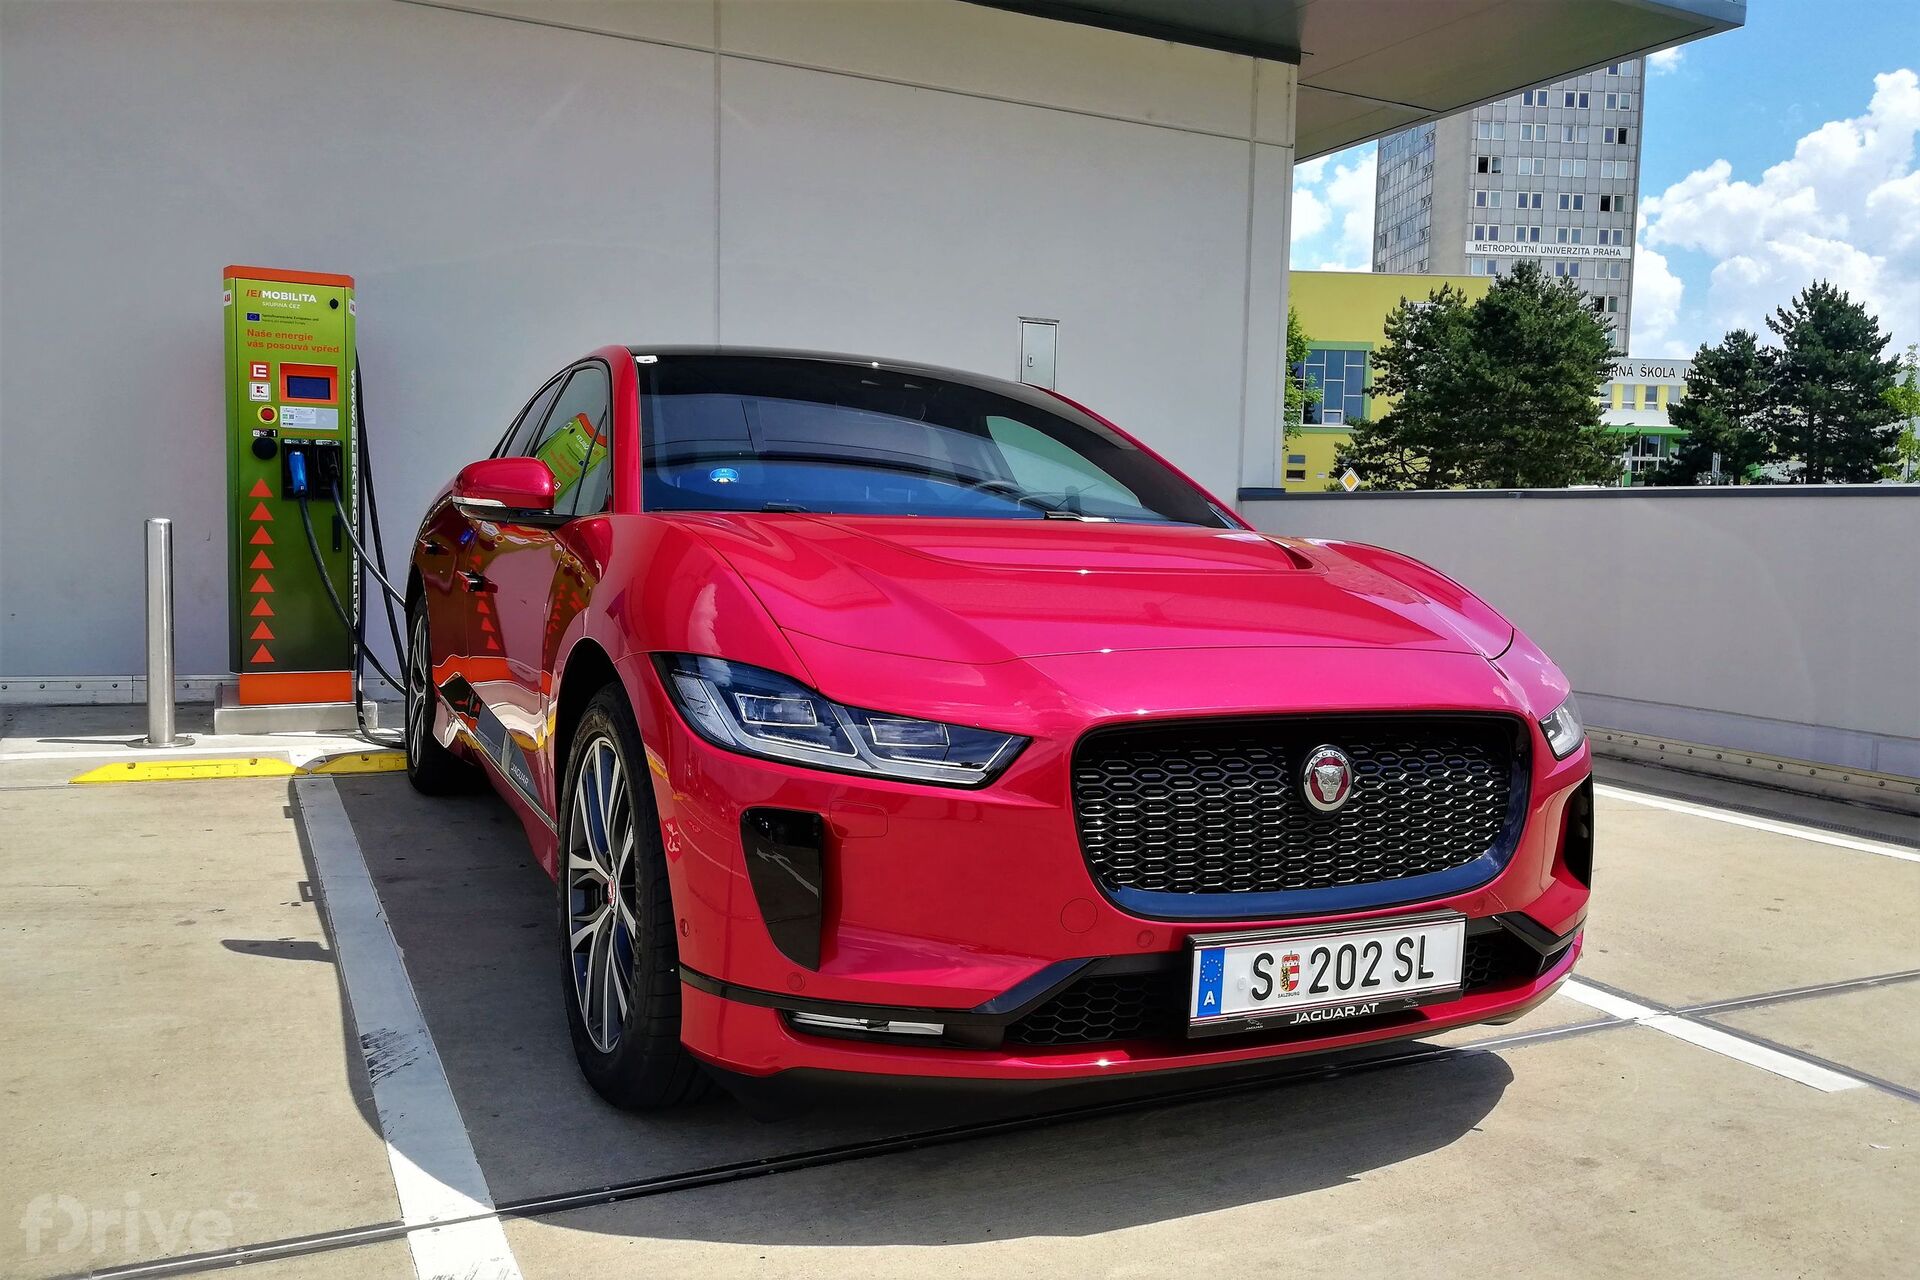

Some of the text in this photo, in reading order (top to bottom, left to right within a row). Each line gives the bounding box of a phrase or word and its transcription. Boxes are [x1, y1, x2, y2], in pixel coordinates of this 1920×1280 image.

[1540, 245, 1590, 256] UNIVERZITA
[1593, 247, 1621, 257] PRAHA
[262, 301, 301, 310] SKUPINA ČEZ
[247, 329, 313, 342] Naše energie
[247, 340, 339, 353] vás posouvá vpřed
[1640, 362, 1676, 378] ŠKOLA
[1310, 751, 1349, 767] JAGUAR
[510, 762, 529, 788] JAGUAR
[1251, 934, 1434, 1001] S 202 SL
[1203, 990, 1217, 1006] A
[1289, 1002, 1379, 1024] JAGUAR.AT
